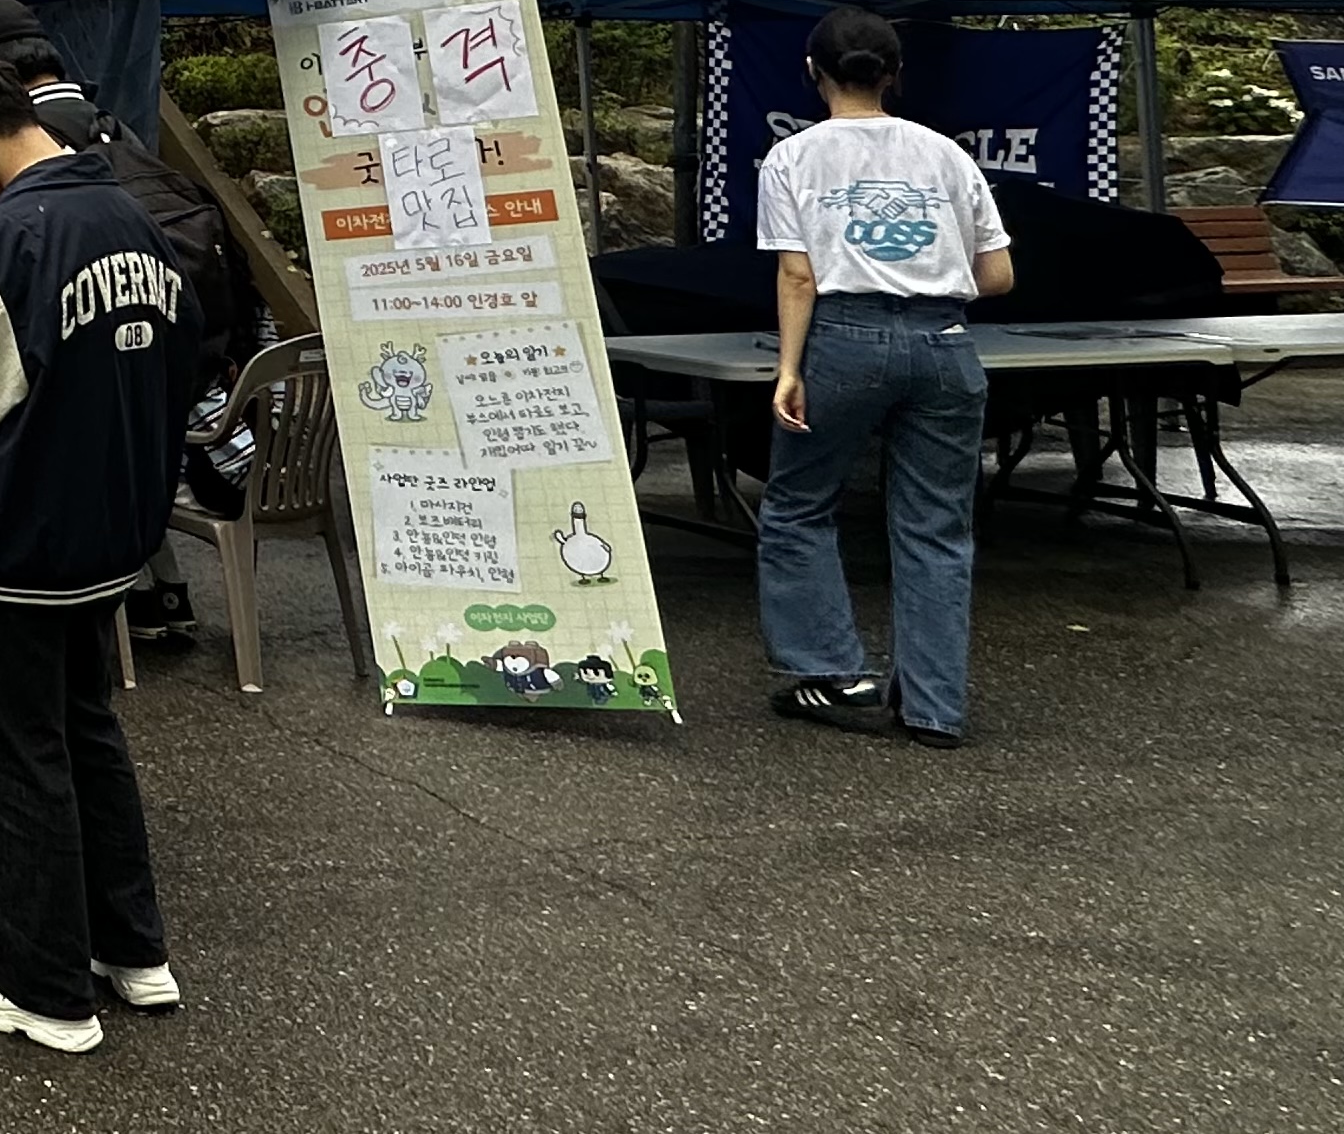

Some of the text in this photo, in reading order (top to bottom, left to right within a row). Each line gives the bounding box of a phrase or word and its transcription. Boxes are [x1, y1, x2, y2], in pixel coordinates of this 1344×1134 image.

[391, 138, 466, 186] 타로
[336, 214, 392, 232] 이차전
[505, 198, 542, 217] 안내
[401, 185, 478, 230] 맛집
[361, 246, 533, 276] 2025년 5월 16일 금요일
[372, 291, 538, 311] 11:00~14:00 인경호 앞
[125, 325, 143, 347] 08
[480, 345, 548, 364] 오늘의 일기
[515, 385, 570, 402] 이차전지
[380, 473, 496, 492] 사업단 굿즈 라인업
